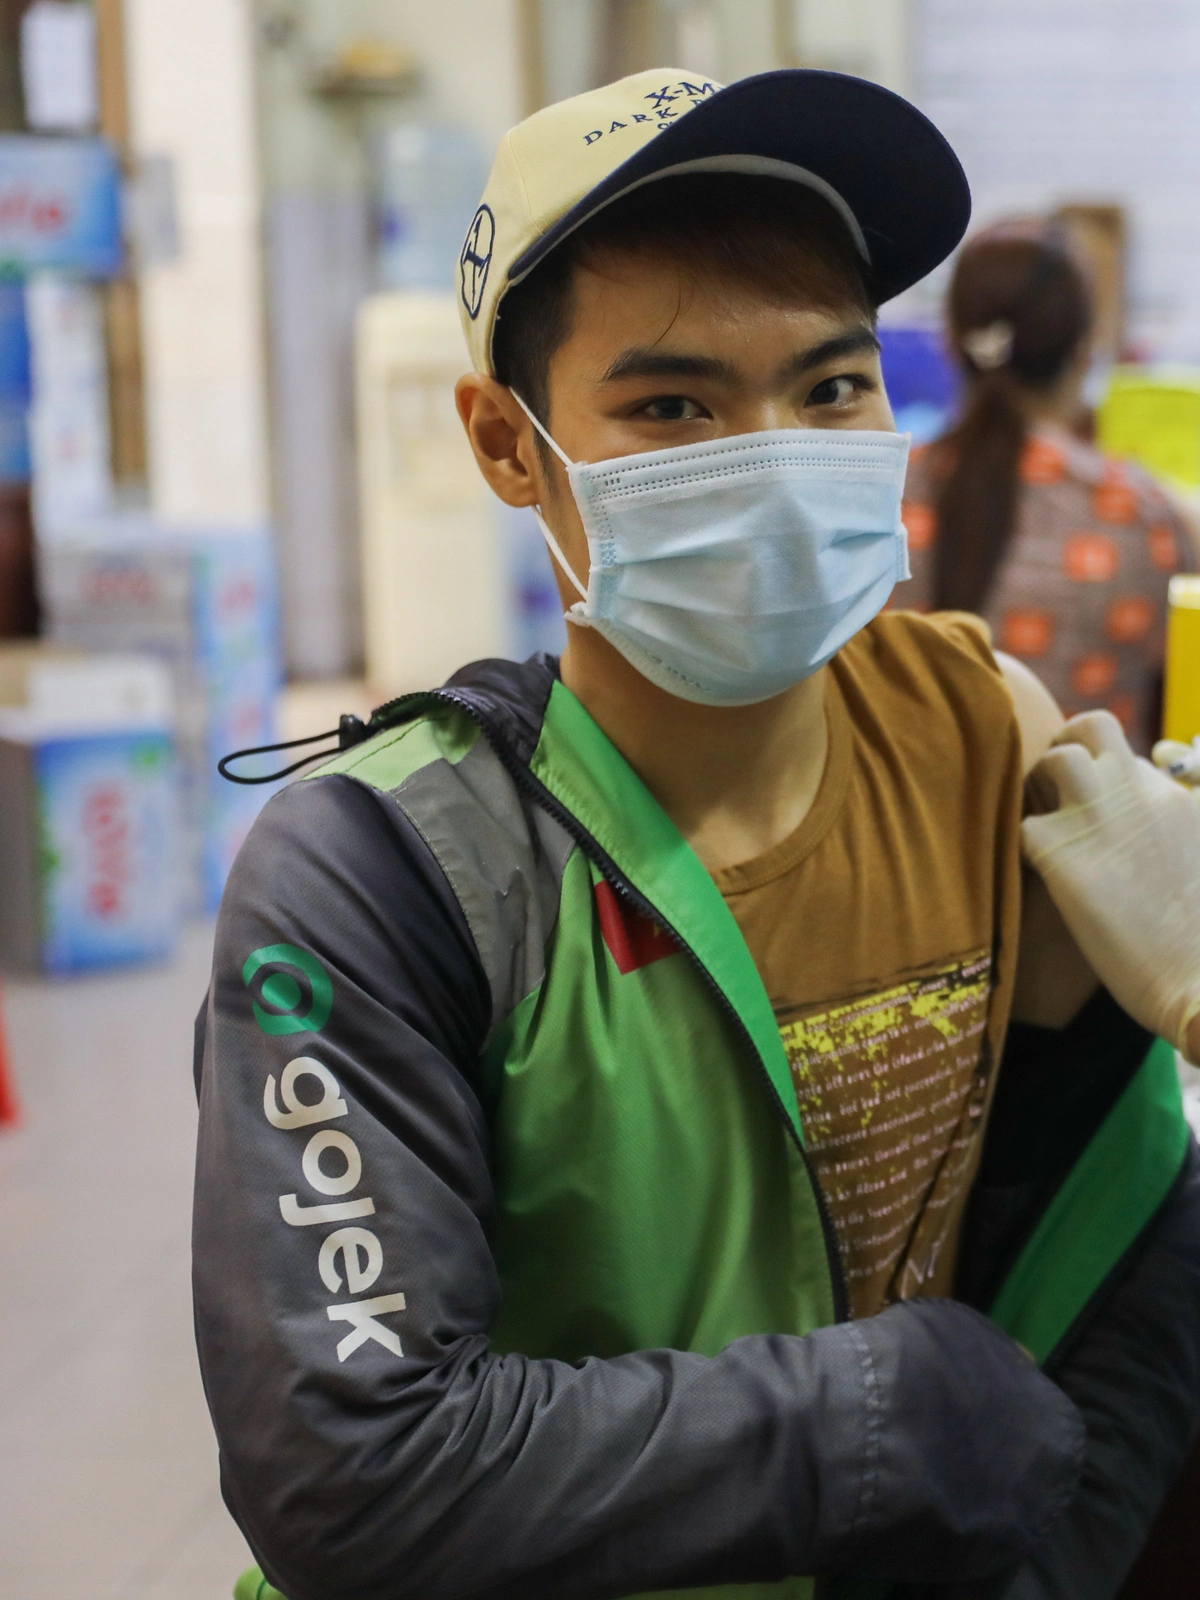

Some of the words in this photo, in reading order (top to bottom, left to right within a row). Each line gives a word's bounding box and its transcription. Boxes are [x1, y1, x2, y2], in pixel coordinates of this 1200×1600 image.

[644, 81, 724, 110] X-M
[582, 106, 679, 146] DARK
[262, 1056, 407, 1364] gojek
